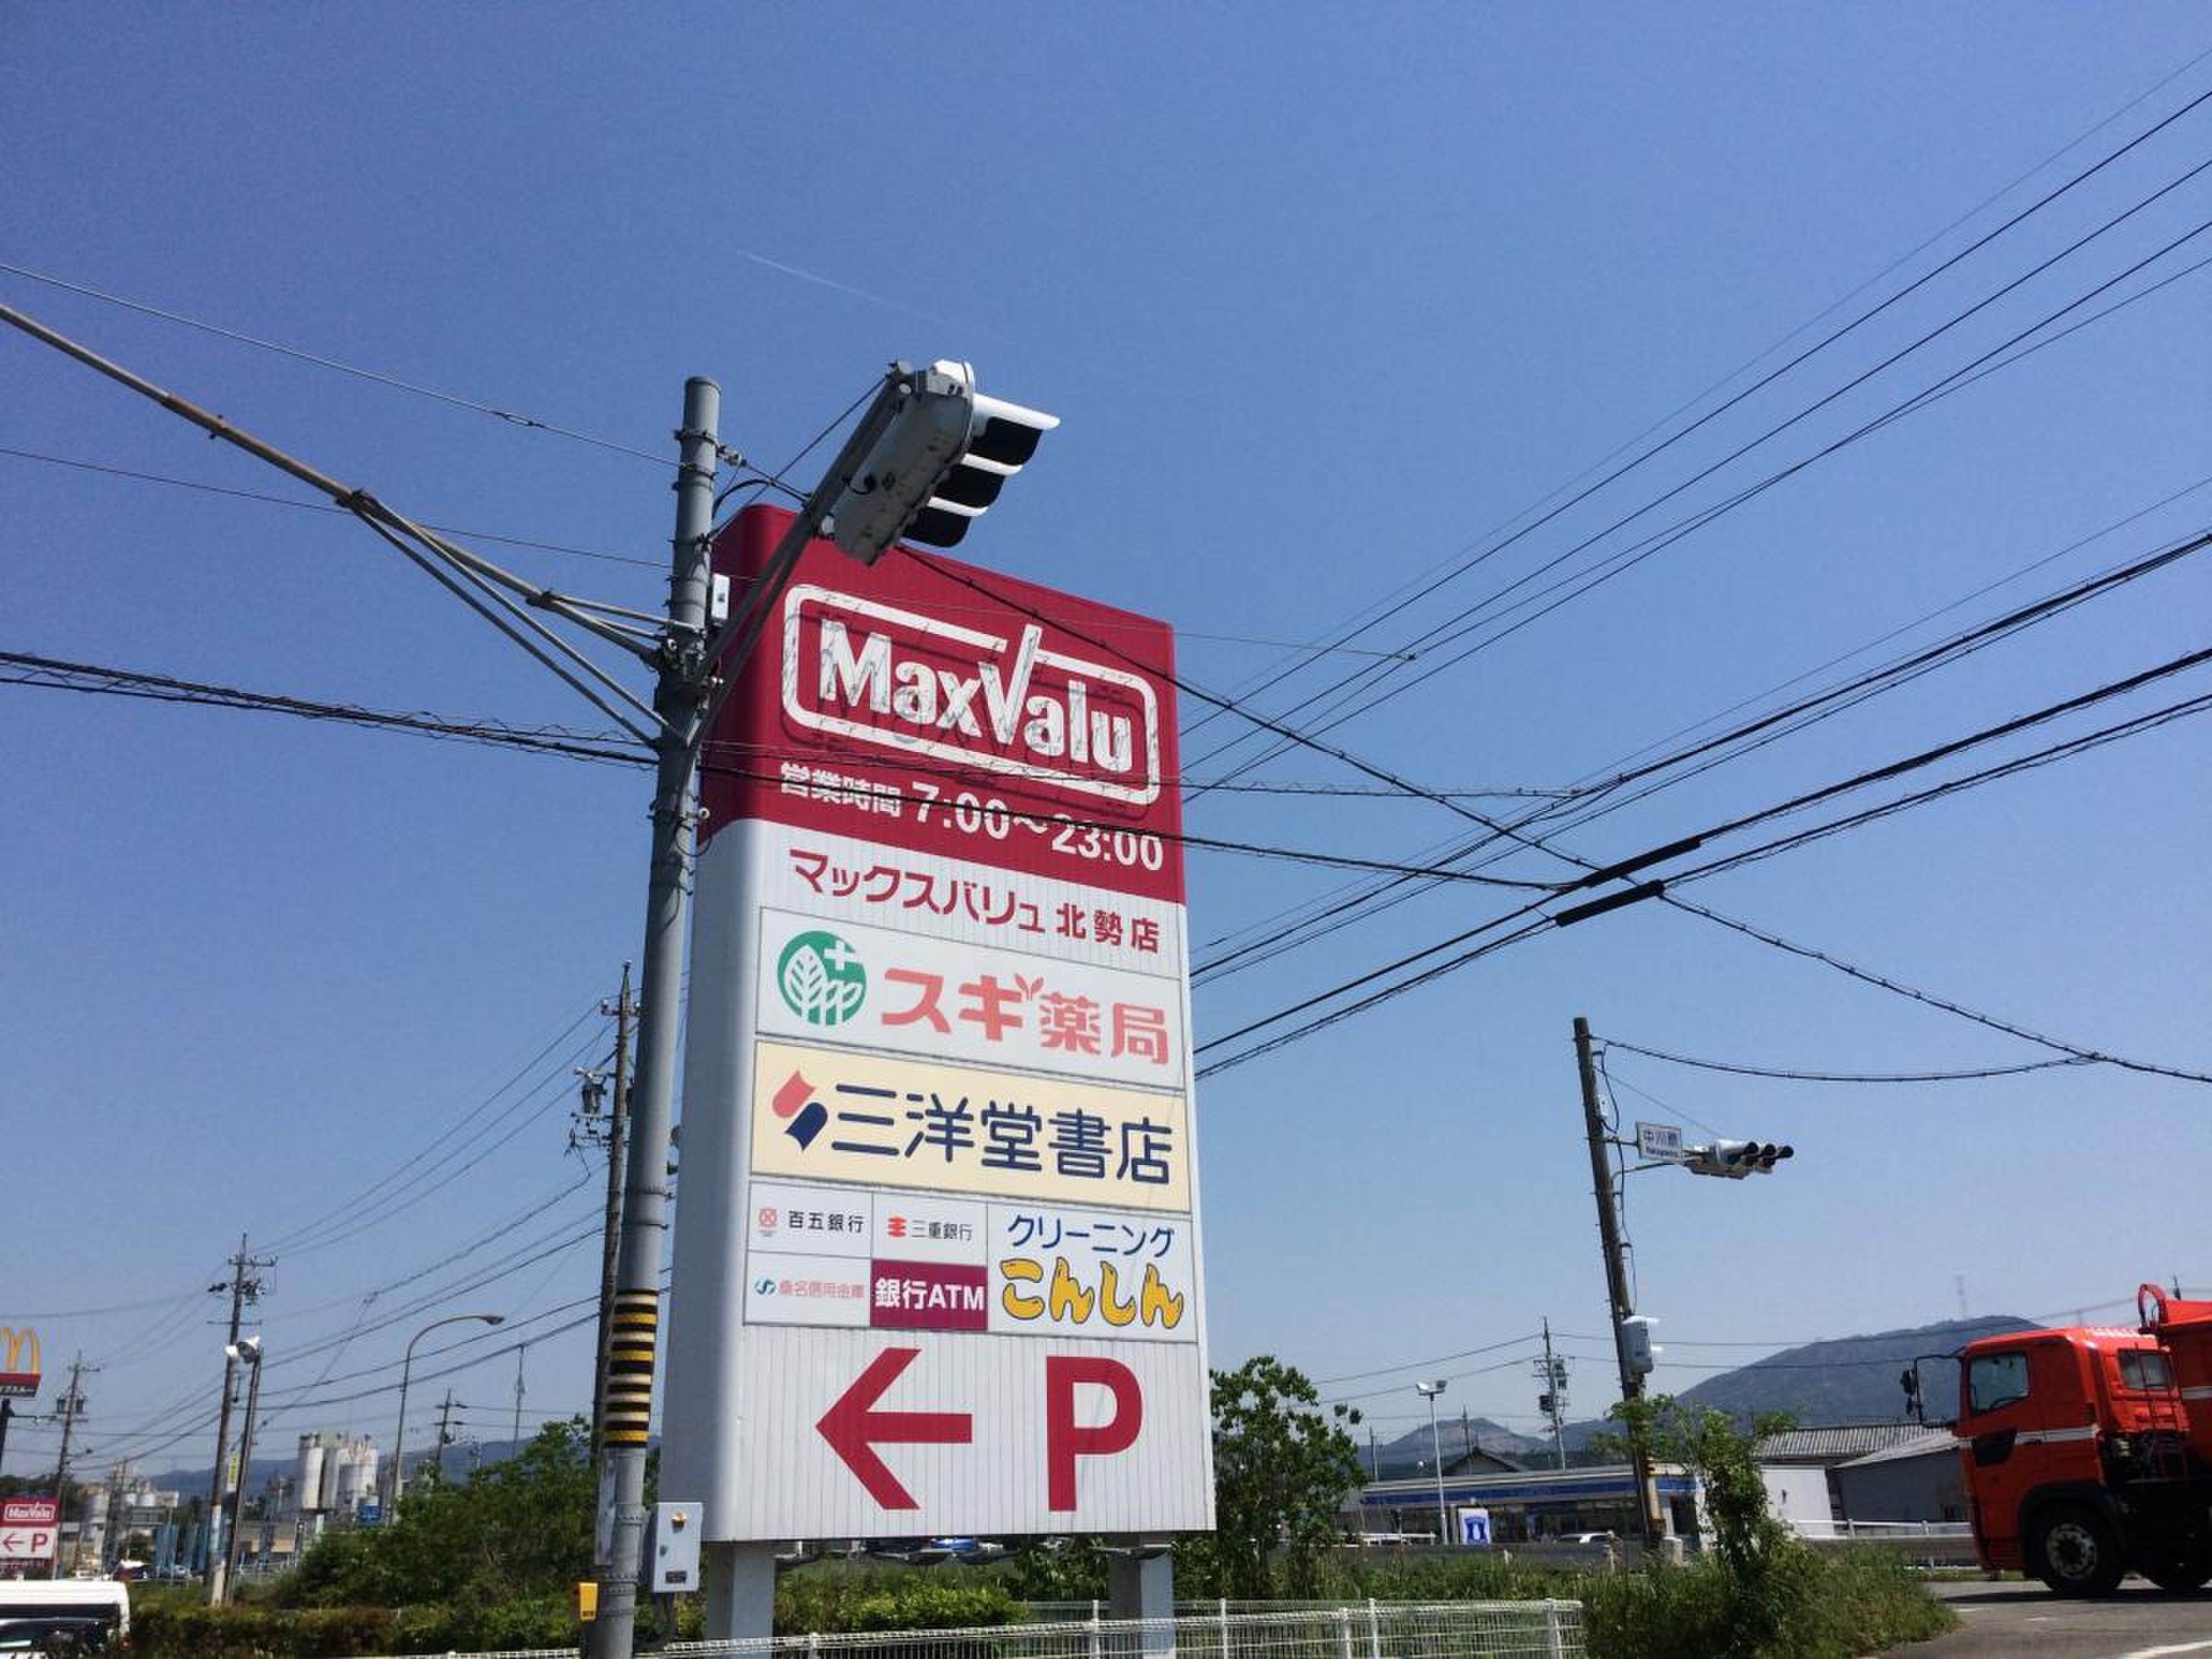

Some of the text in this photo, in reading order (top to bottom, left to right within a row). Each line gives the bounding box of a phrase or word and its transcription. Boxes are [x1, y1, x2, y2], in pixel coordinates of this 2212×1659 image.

[818, 618, 1133, 773] MaxValu
[781, 761, 901, 818] 営業時間
[880, 967, 1170, 1065] スギ薬局
[830, 1082, 1174, 1185] 三洋堂書店
[788, 1209, 865, 1233] 百五銀行
[911, 1218, 973, 1241] 三重銀行
[1007, 1214, 1175, 1257] クリーニング
[875, 1277, 984, 1312] 銀行ATM
[1000, 1256, 1184, 1329] こんしん
[1046, 1355, 1144, 1512] P
[30, 1533, 49, 1553] P
